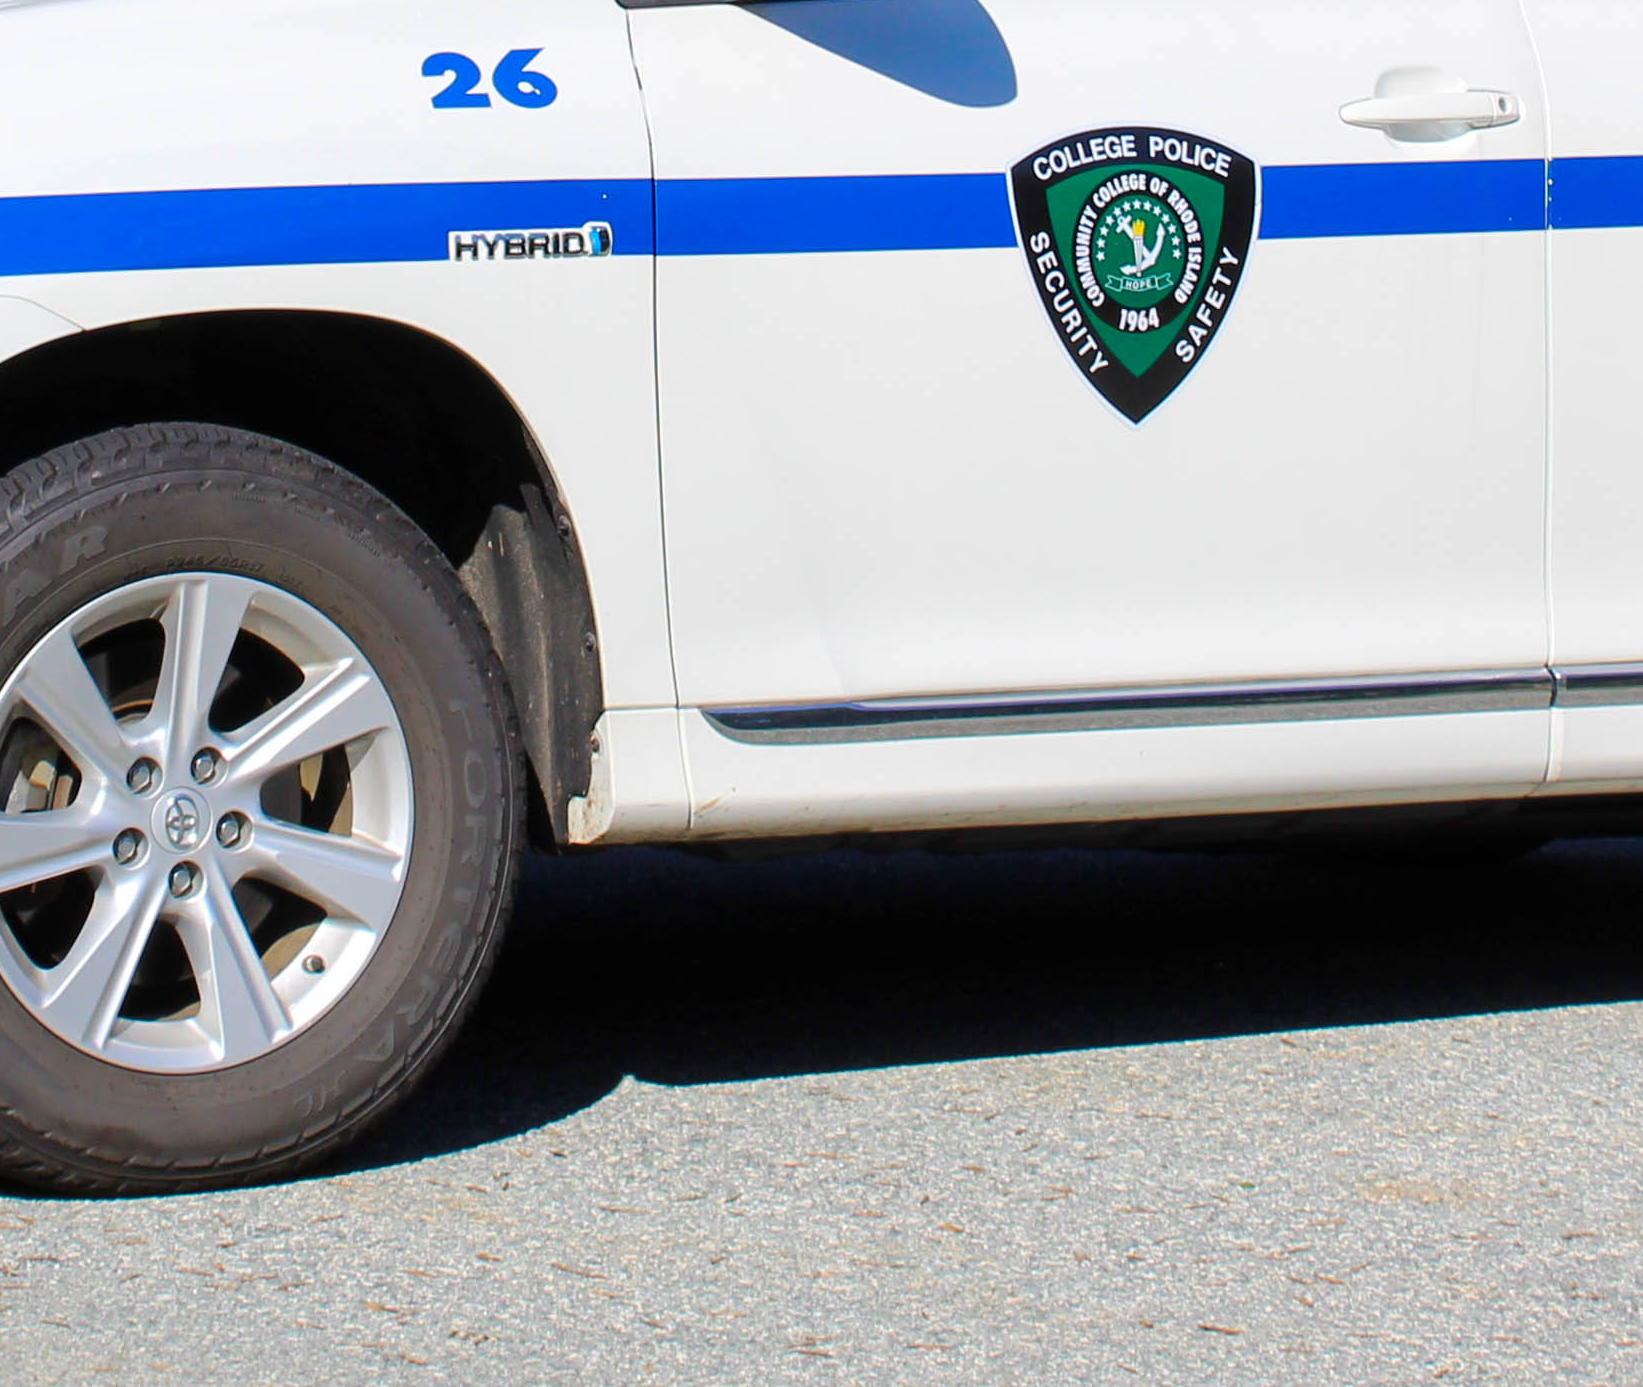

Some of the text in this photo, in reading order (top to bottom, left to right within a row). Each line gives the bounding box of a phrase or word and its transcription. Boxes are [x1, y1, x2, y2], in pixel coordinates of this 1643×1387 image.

[421, 47, 558, 109] 26
[1033, 135, 1232, 181] COLLEGE POLICE
[455, 232, 585, 261] HYBRID
[1075, 173, 1202, 307] COMMUNITY COLLEGE OF RHODE ISLAND
[1030, 231, 1109, 374] SECURITY
[1125, 279, 1152, 290] HOPE
[1175, 246, 1239, 363] SAFETY
[1119, 307, 1160, 332] 1964
